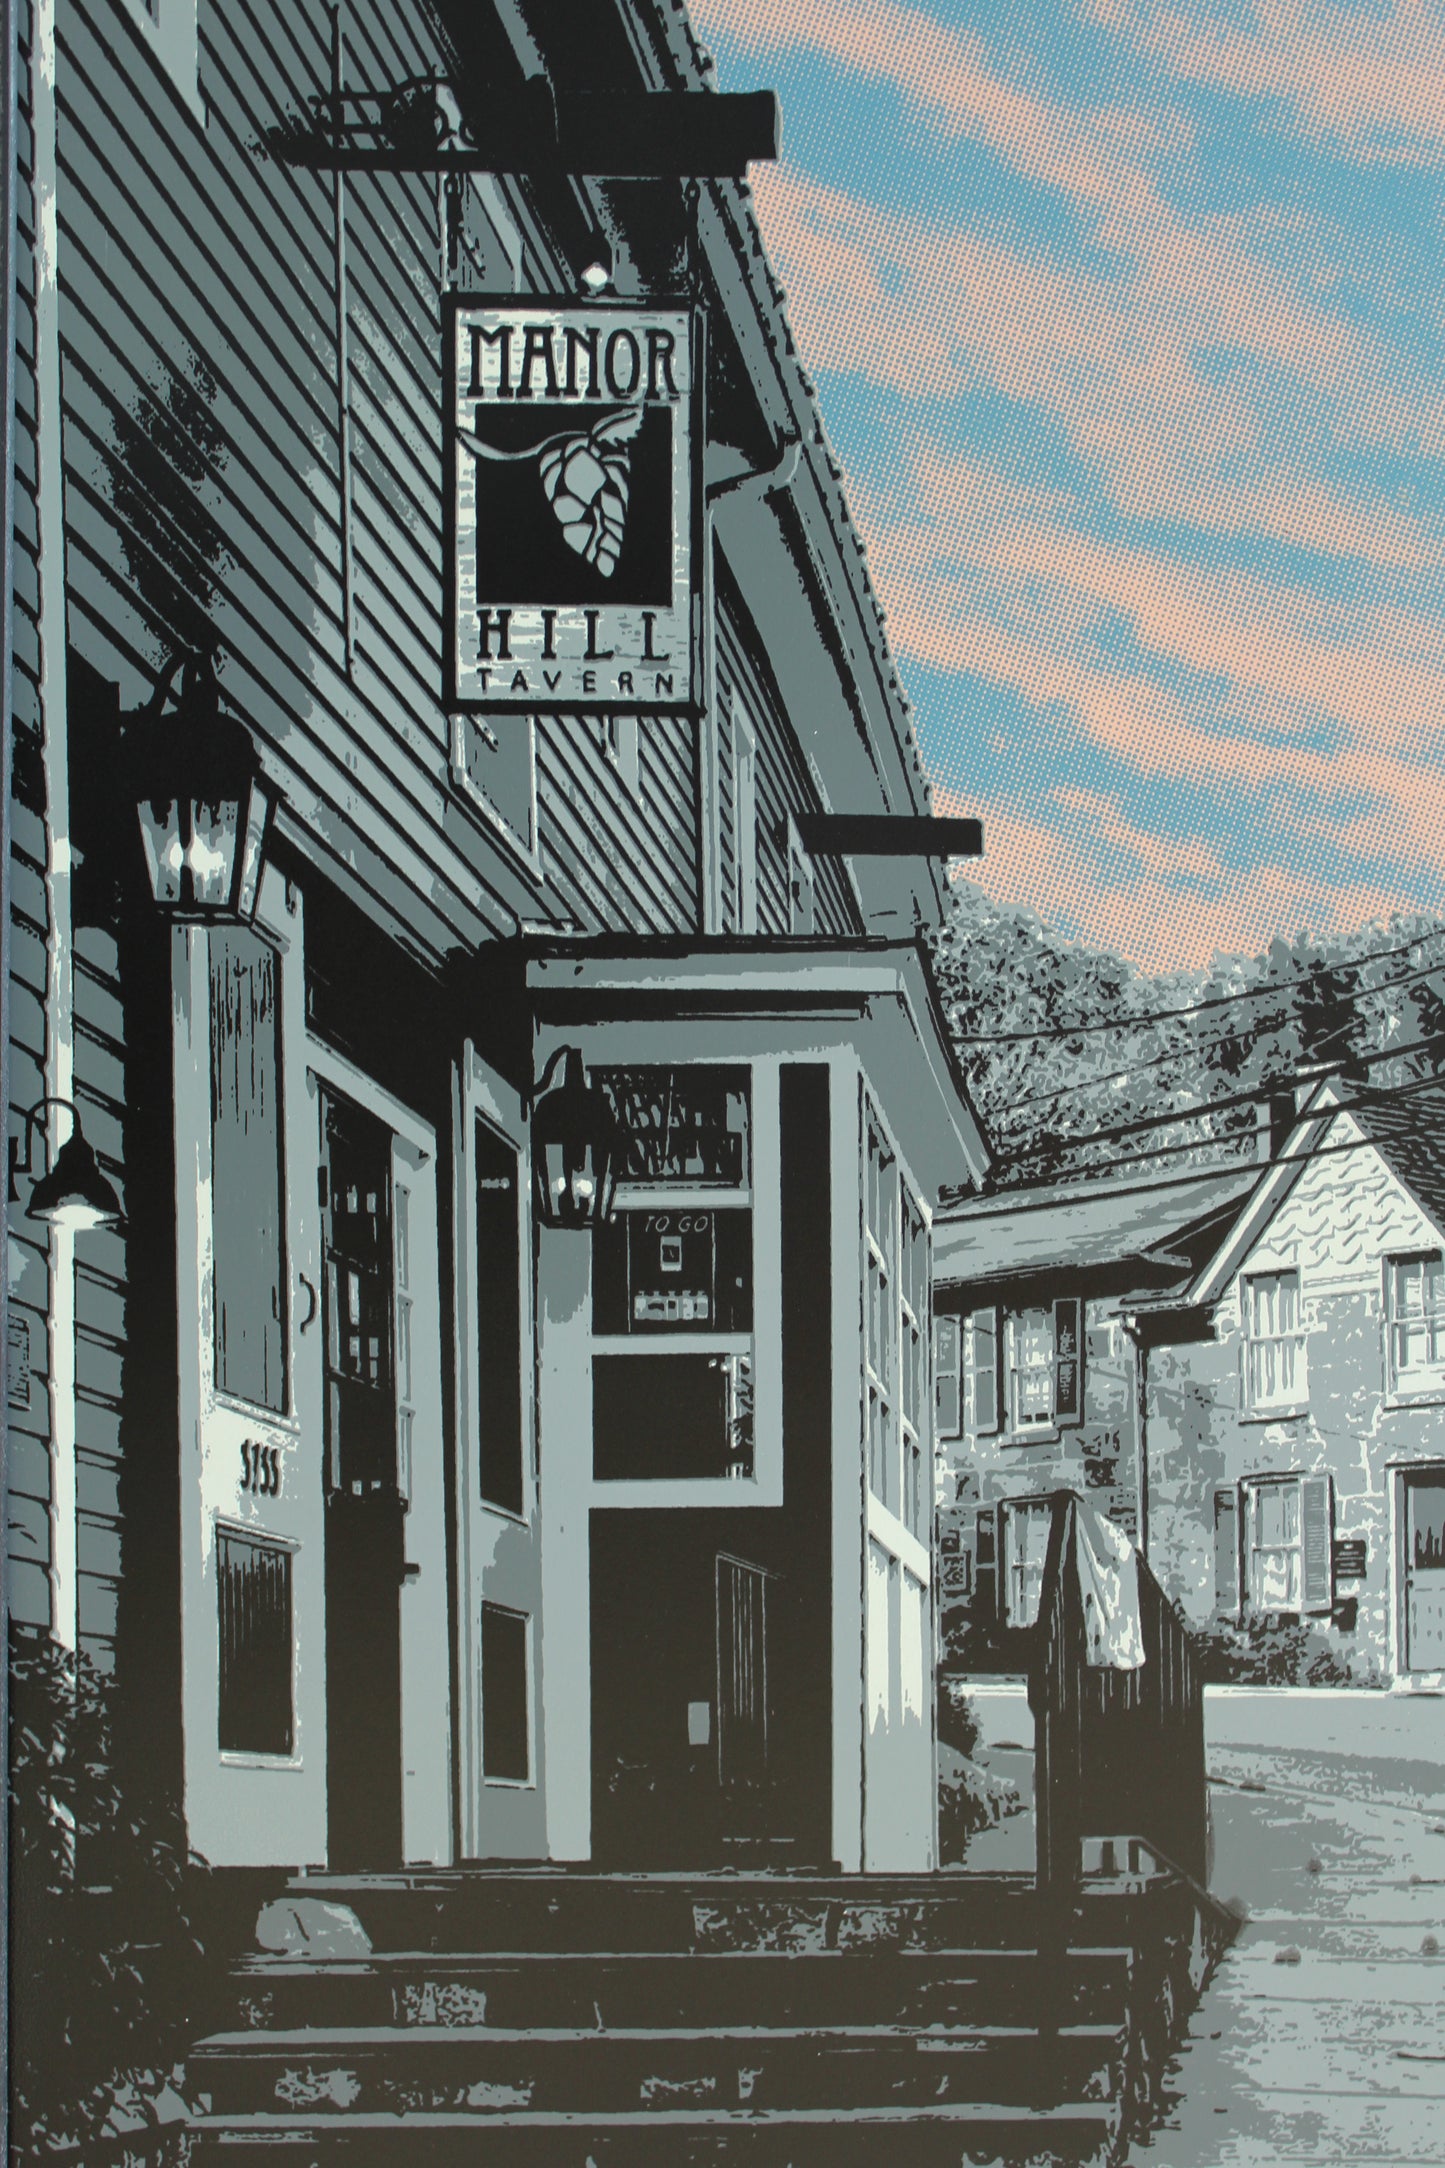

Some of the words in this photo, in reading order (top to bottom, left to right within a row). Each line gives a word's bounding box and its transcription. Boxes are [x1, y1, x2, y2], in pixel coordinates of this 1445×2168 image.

[467, 325, 681, 399] MANOR
[476, 609, 669, 660] HILL
[477, 668, 674, 694] TAVERN
[645, 1215, 670, 1233] TO
[678, 1215, 709, 1233] GO
